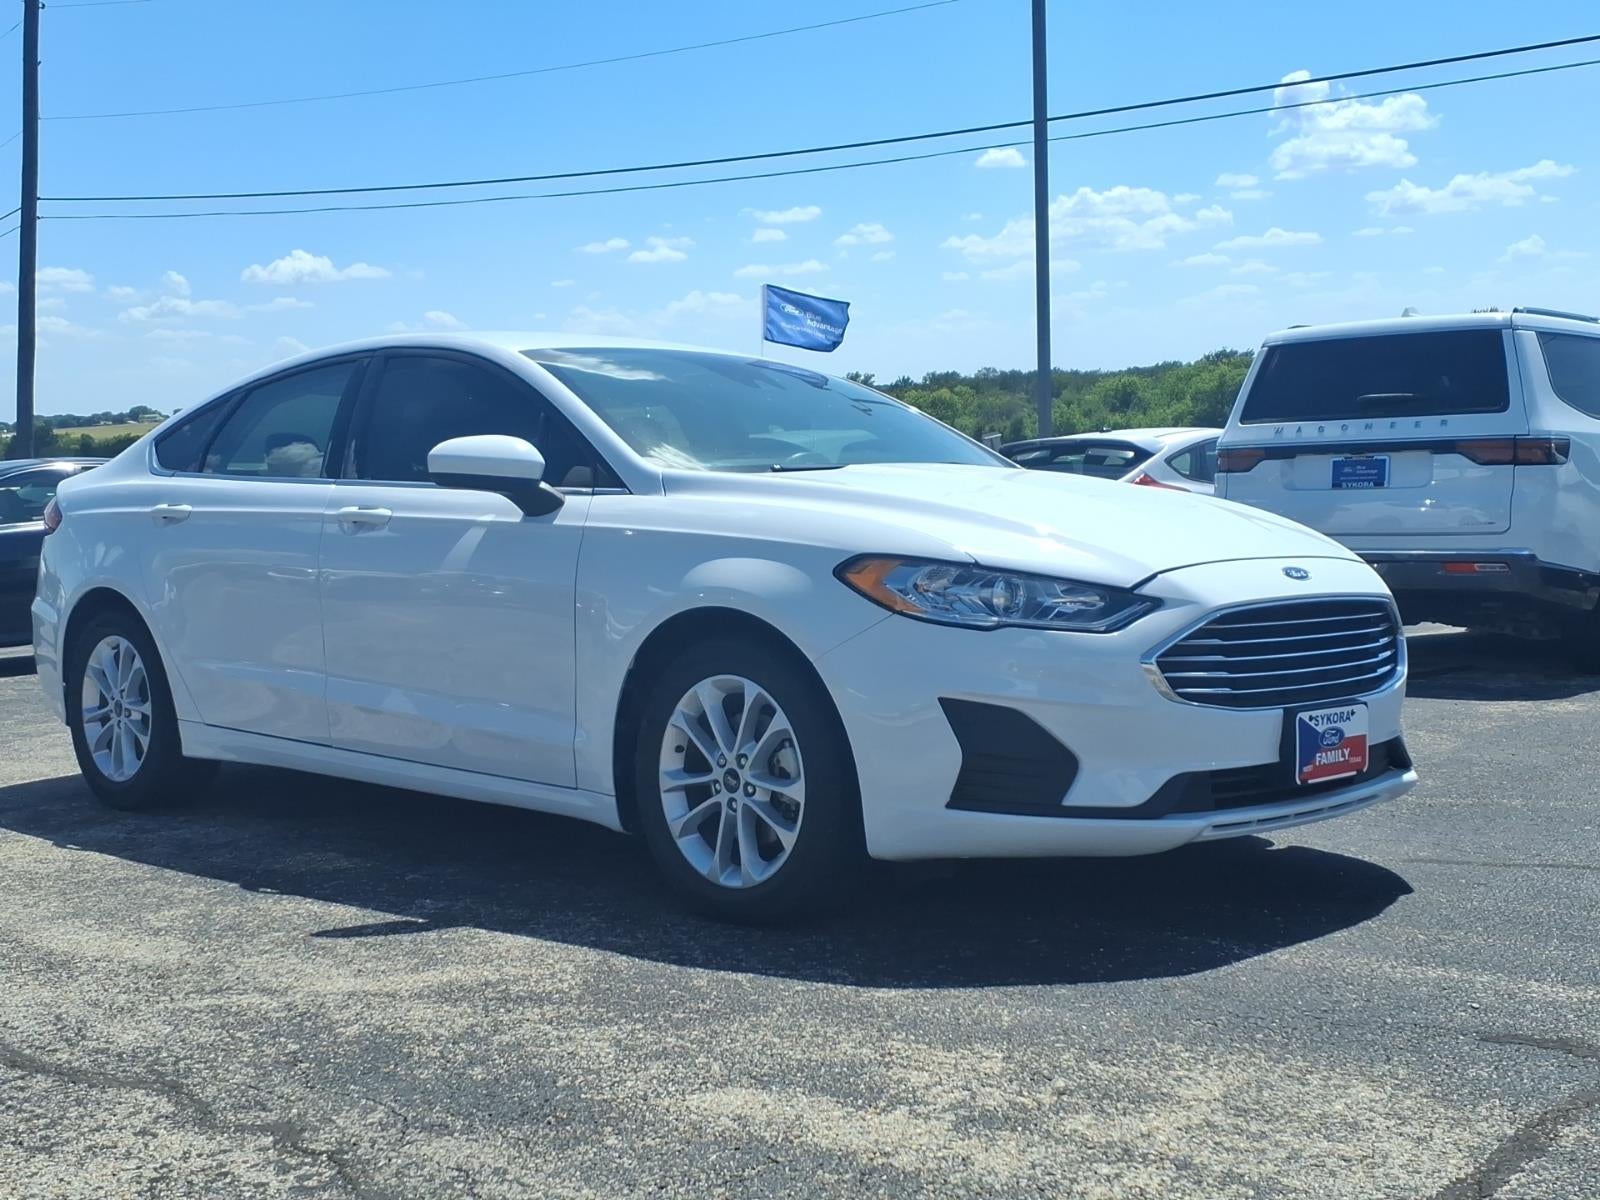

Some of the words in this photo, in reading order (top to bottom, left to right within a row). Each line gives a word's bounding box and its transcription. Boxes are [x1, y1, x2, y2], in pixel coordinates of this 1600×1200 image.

[1272, 419, 1449, 434] WAGONEER
[1313, 710, 1352, 727] SYKORA
[1315, 748, 1350, 766] FAMILY
